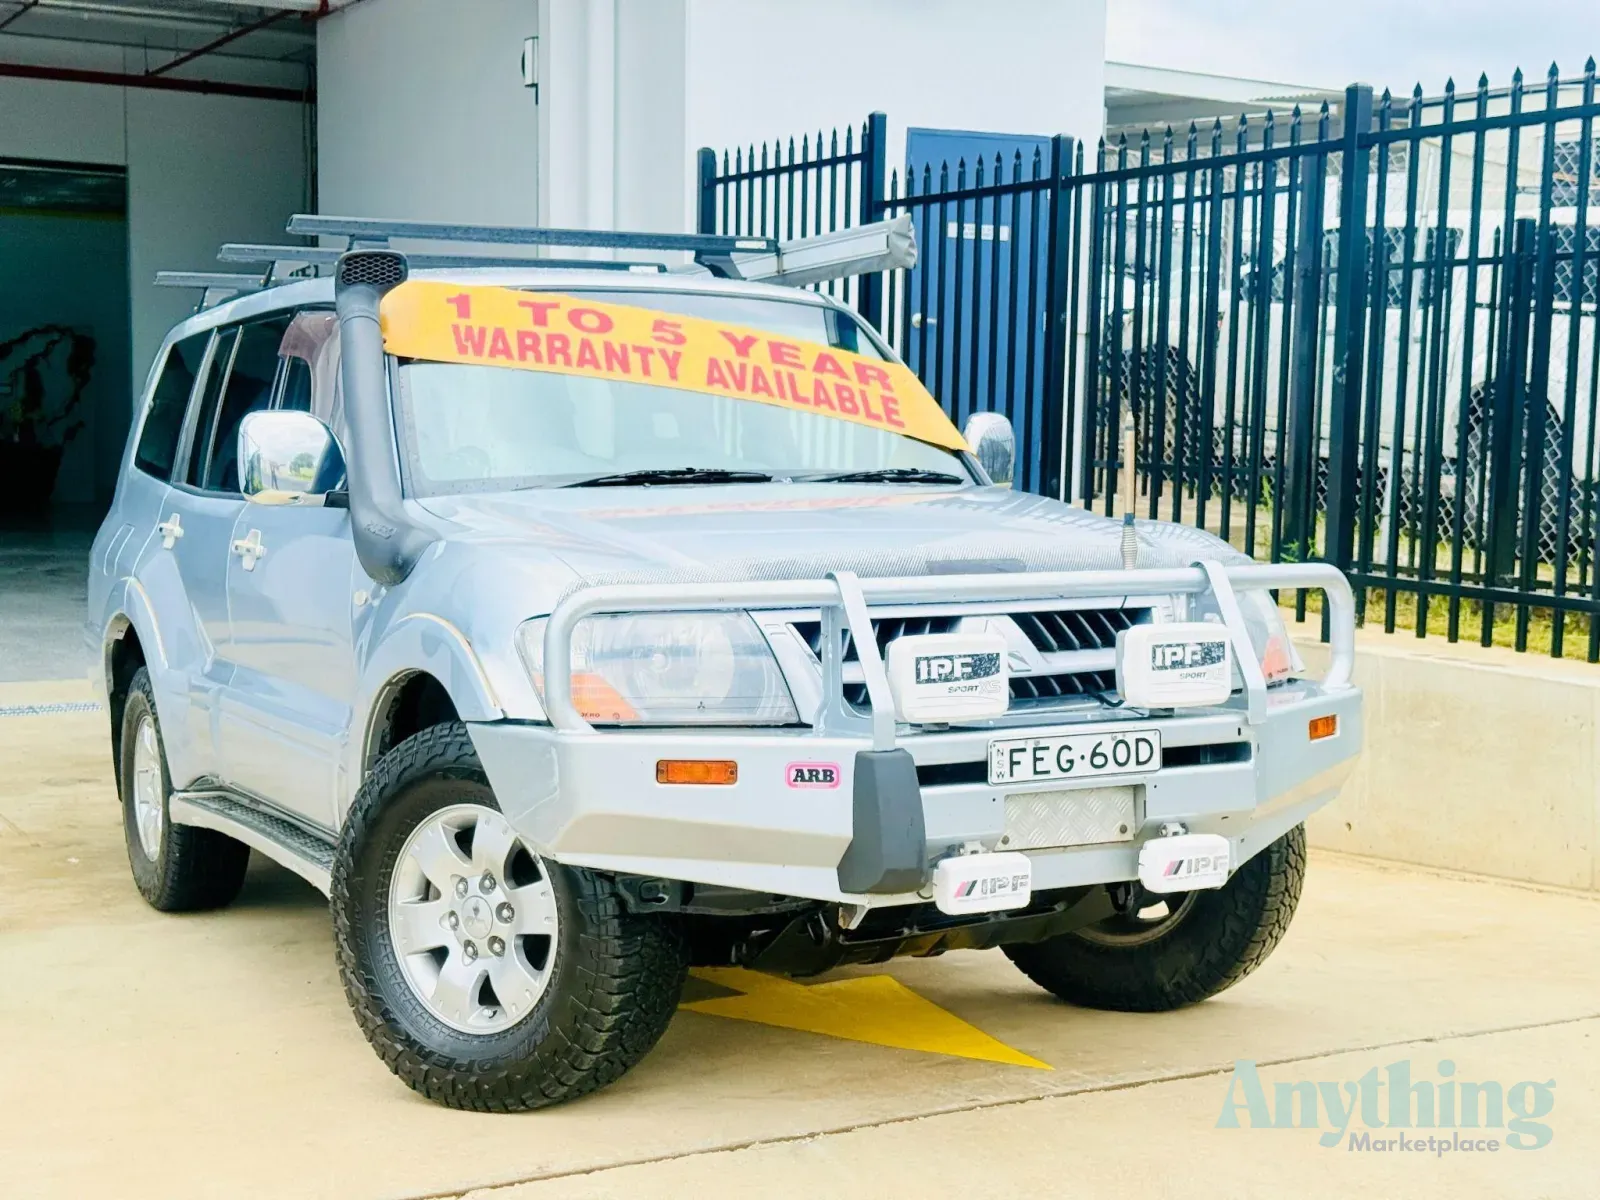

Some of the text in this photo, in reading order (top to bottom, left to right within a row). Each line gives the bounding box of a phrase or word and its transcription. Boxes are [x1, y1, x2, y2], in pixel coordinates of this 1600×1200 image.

[446, 293, 894, 392] 1 TO 5 YEAR
[451, 323, 905, 428] WARRANTY AVAILABLE
[1155, 645, 1202, 666] IPF
[919, 657, 973, 681] IPF
[1179, 671, 1207, 679] SPORT
[948, 685, 979, 694] SPORT
[792, 768, 835, 783] ARB
[981, 874, 1029, 895] IPF
